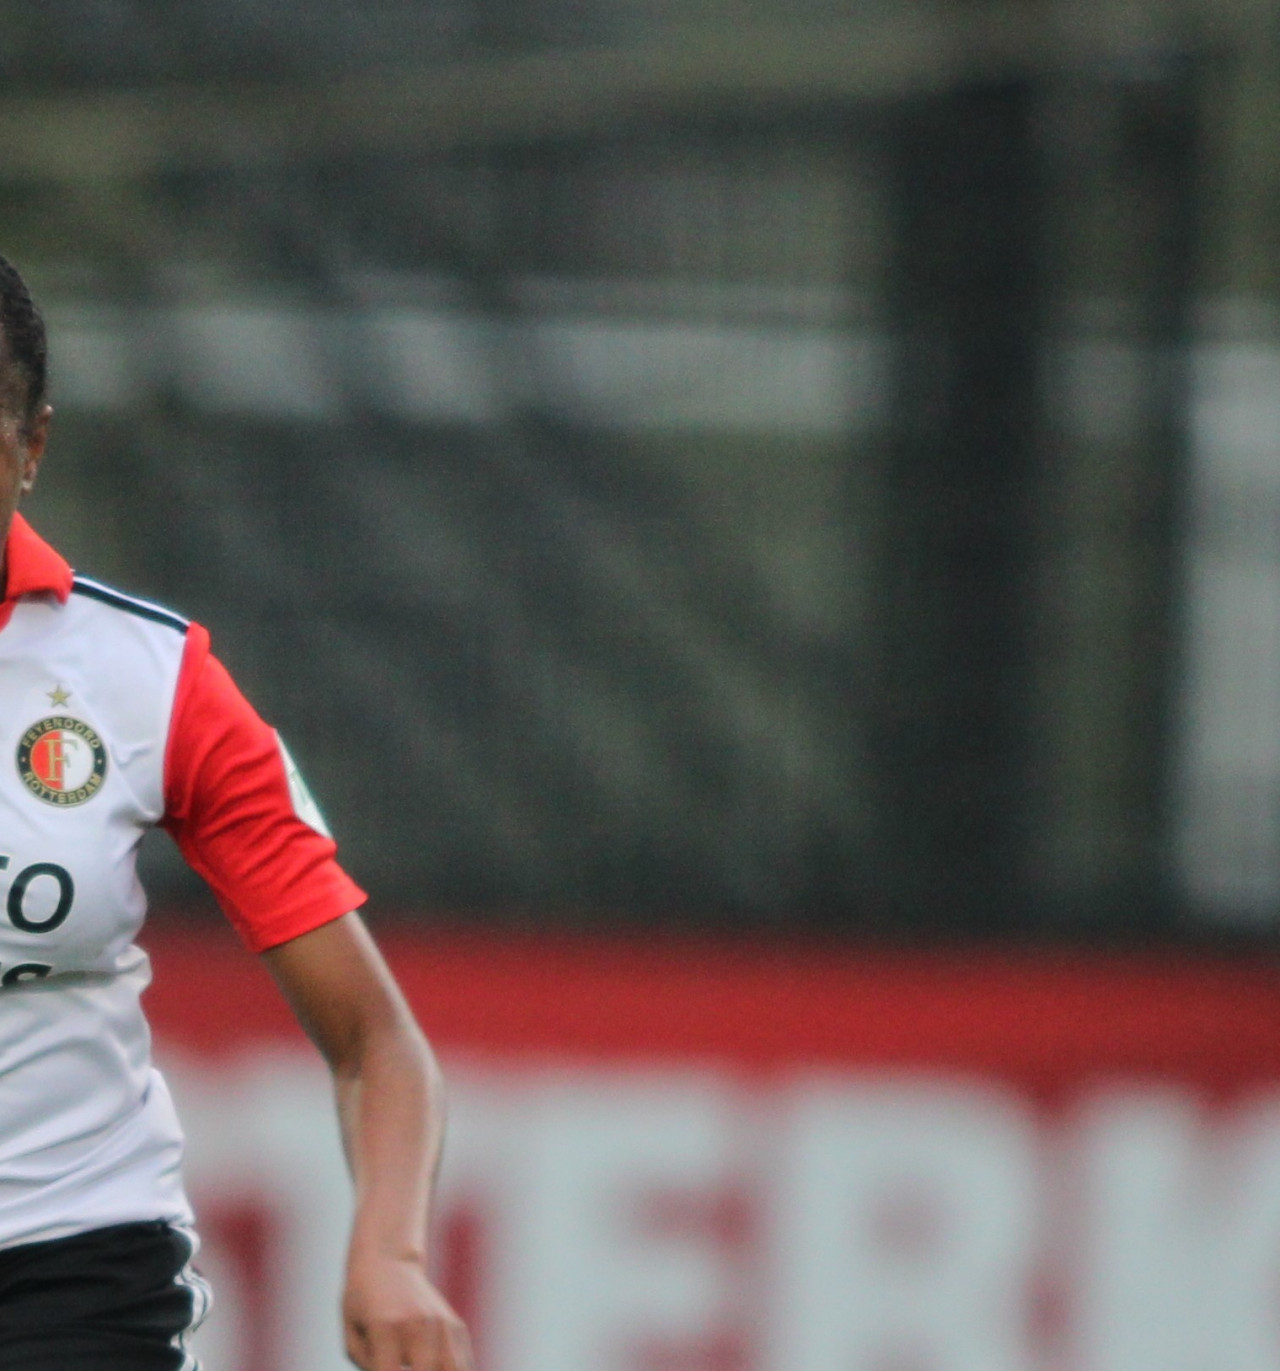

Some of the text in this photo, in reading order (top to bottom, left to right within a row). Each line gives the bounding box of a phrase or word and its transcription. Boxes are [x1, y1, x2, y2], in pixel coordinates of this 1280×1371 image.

[21, 718, 101, 749] FEYENOORD
[41, 738, 79, 782] F
[22, 771, 102, 804] ROTTERDAM
